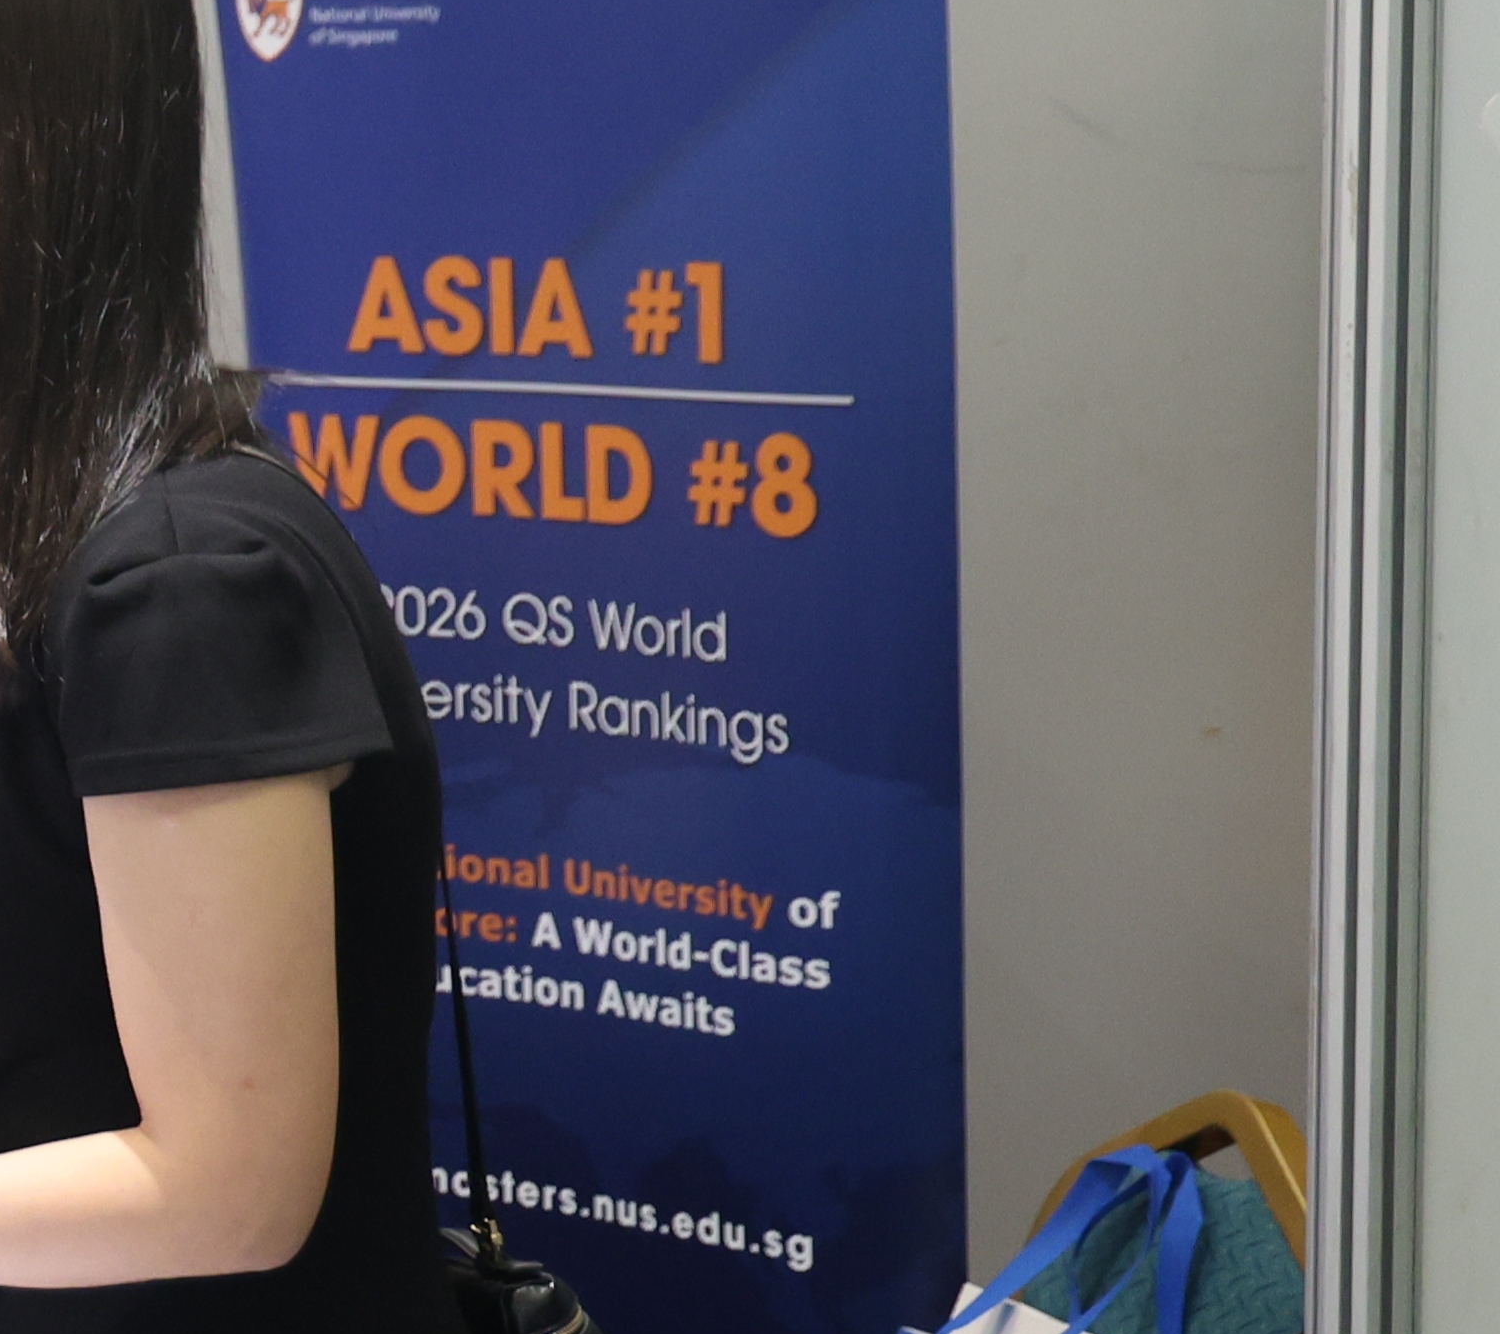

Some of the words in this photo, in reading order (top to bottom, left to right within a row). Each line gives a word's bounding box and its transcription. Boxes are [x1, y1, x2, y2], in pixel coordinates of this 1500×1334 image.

[309, 6, 368, 24] National
[373, 3, 442, 26] University
[309, 27, 327, 44] of
[328, 28, 398, 49] Singapore
[346, 255, 594, 359] ASIA
[623, 260, 726, 366] #1
[287, 411, 653, 527] WORLD
[687, 431, 819, 539] #8
[502, 591, 575, 648] QS
[587, 598, 729, 663] World
[421, 673, 553, 739] ersity
[568, 680, 790, 765] Rankings
[437, 843, 551, 891] ional
[563, 857, 774, 931] University
[787, 889, 842, 931] of
[531, 911, 563, 950] A
[572, 916, 832, 990] World-Class
[596, 978, 737, 1038] Awaits
